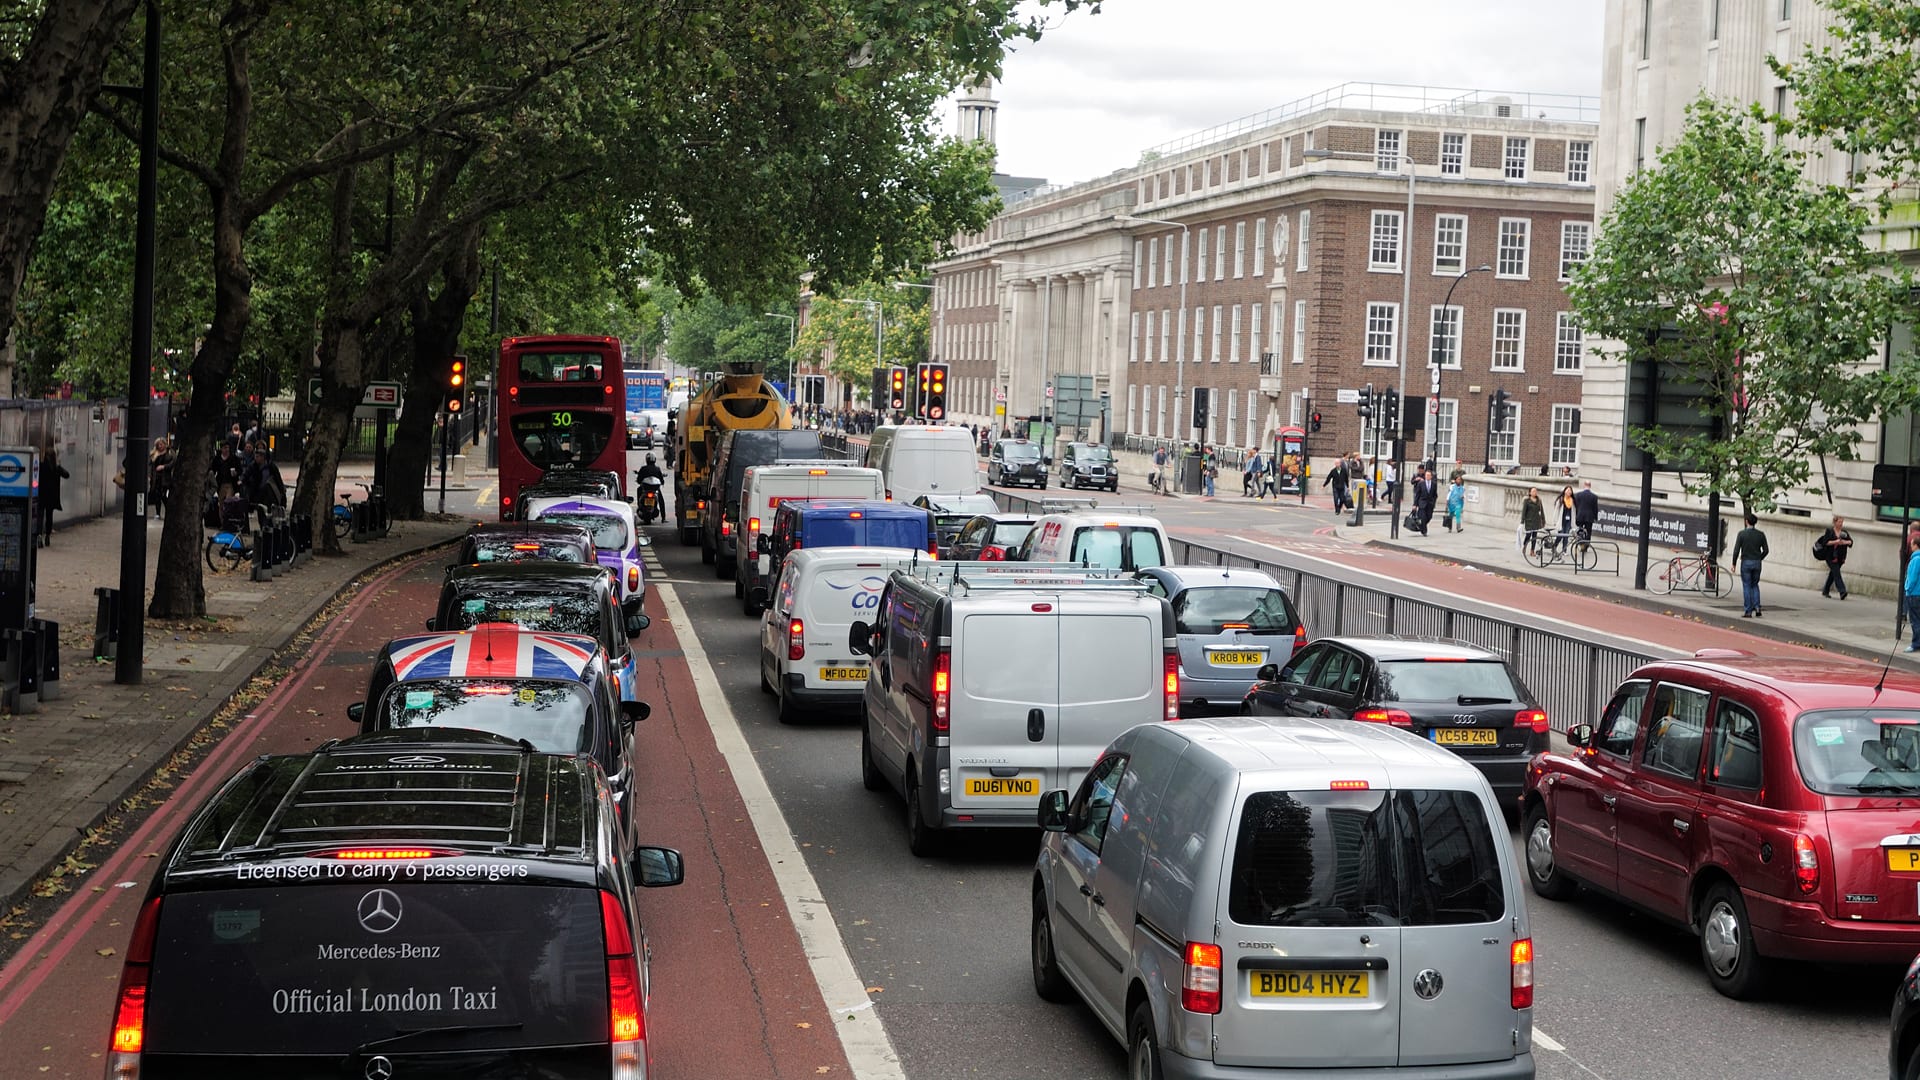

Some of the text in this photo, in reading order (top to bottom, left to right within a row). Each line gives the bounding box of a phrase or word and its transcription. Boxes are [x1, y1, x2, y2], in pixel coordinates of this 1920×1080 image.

[552, 412, 572, 426] 30
[1607, 512, 1616, 521] and
[1616, 512, 1630, 525] comfy
[1662, 520, 1669, 529] as
[1670, 520, 1680, 531] well
[1680, 523, 1686, 532] as
[1617, 526, 1626, 535] and
[1626, 528, 1629, 536] a
[1664, 532, 1678, 544] Come
[1214, 652, 1258, 663] KR08 YMS
[825, 669, 846, 678] MF10
[1438, 730, 1469, 741] YC58
[974, 780, 1032, 793] DU61 VNO
[238, 860, 528, 882] Licensed to carry 6 passengers
[317, 943, 441, 960] Mercedes-Benz
[1238, 940, 1276, 949] CADDY
[1260, 973, 1362, 995] BD04 HYZ
[272, 986, 497, 1014] Official London Taxi
